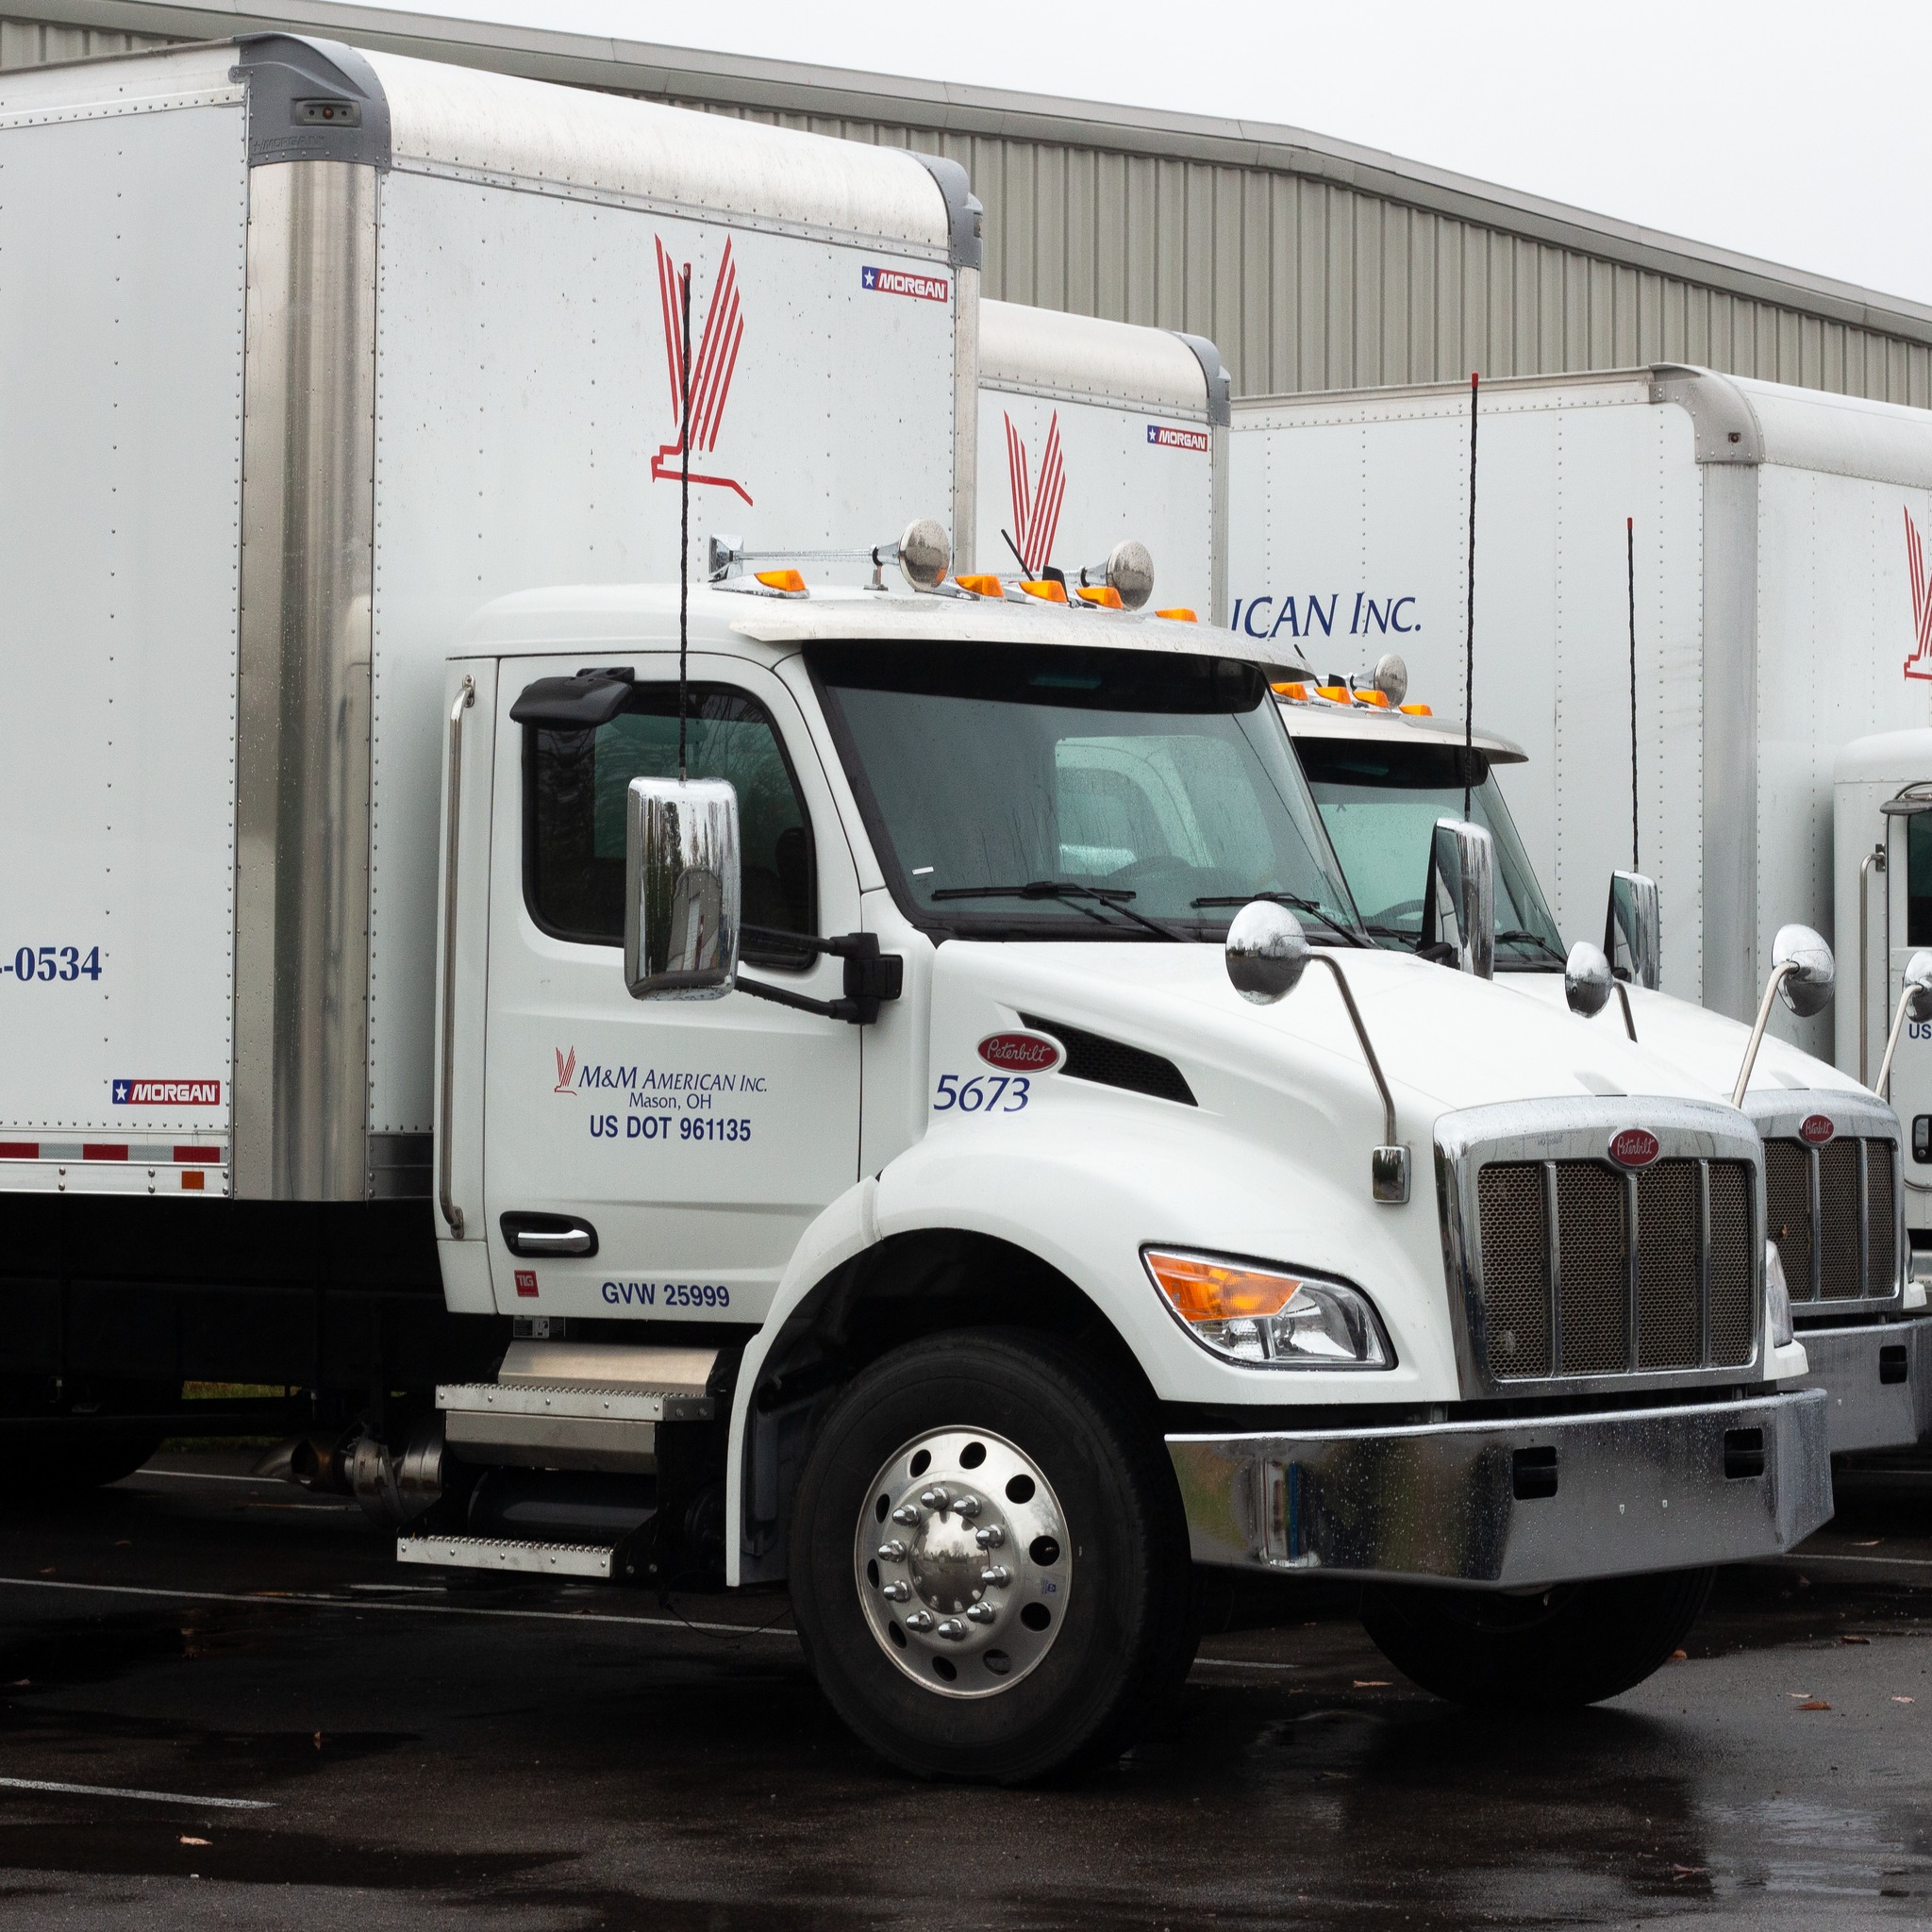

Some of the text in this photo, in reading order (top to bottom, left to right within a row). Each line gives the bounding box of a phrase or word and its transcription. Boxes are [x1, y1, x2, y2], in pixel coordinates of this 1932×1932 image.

[878, 272, 944, 300] MORGAN
[1158, 429, 1206, 450] MORGAN
[1349, 592, 1422, 635] INC.
[0, 946, 102, 981] -0534
[1909, 1024, 1932, 1040] US
[987, 1039, 1051, 1062] Peterbilt
[578, 1065, 767, 1092] M&M AMERICAN INC.
[132, 1084, 215, 1102] MORGAN
[629, 1092, 711, 1110] Mason, OH
[933, 1074, 1030, 1112] 5673
[590, 1115, 751, 1141] US DOT 961135
[1617, 1136, 1655, 1157] Peterbilt
[602, 1282, 730, 1307] GVW 25999
